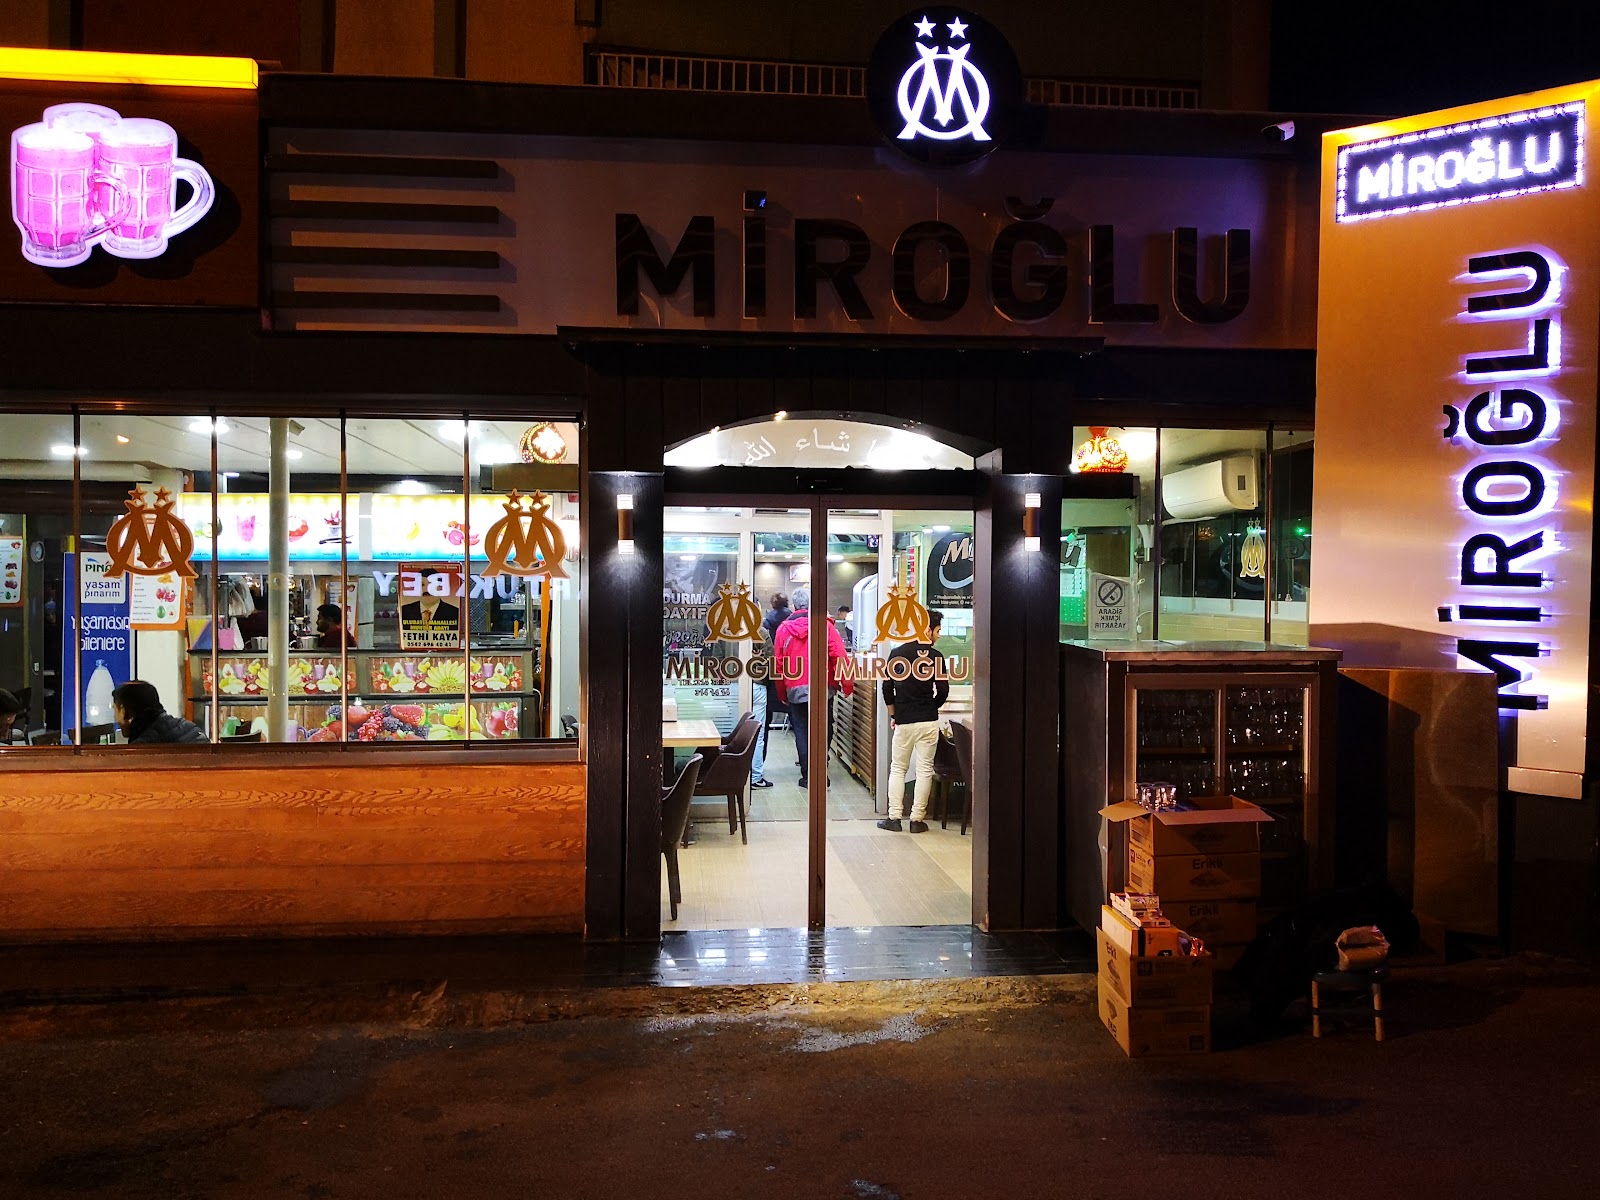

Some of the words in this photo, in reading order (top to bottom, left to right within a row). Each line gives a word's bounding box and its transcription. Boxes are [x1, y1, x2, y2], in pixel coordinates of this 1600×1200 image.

[1356, 131, 1562, 204] MİROĞLU
[615, 190, 1251, 324] MİROĞLU
[1437, 249, 1551, 711] MİROĞLU
[85, 580, 120, 590] yaşam
[403, 630, 428, 640] FETHİ
[665, 649, 804, 681] MİROĞLU
